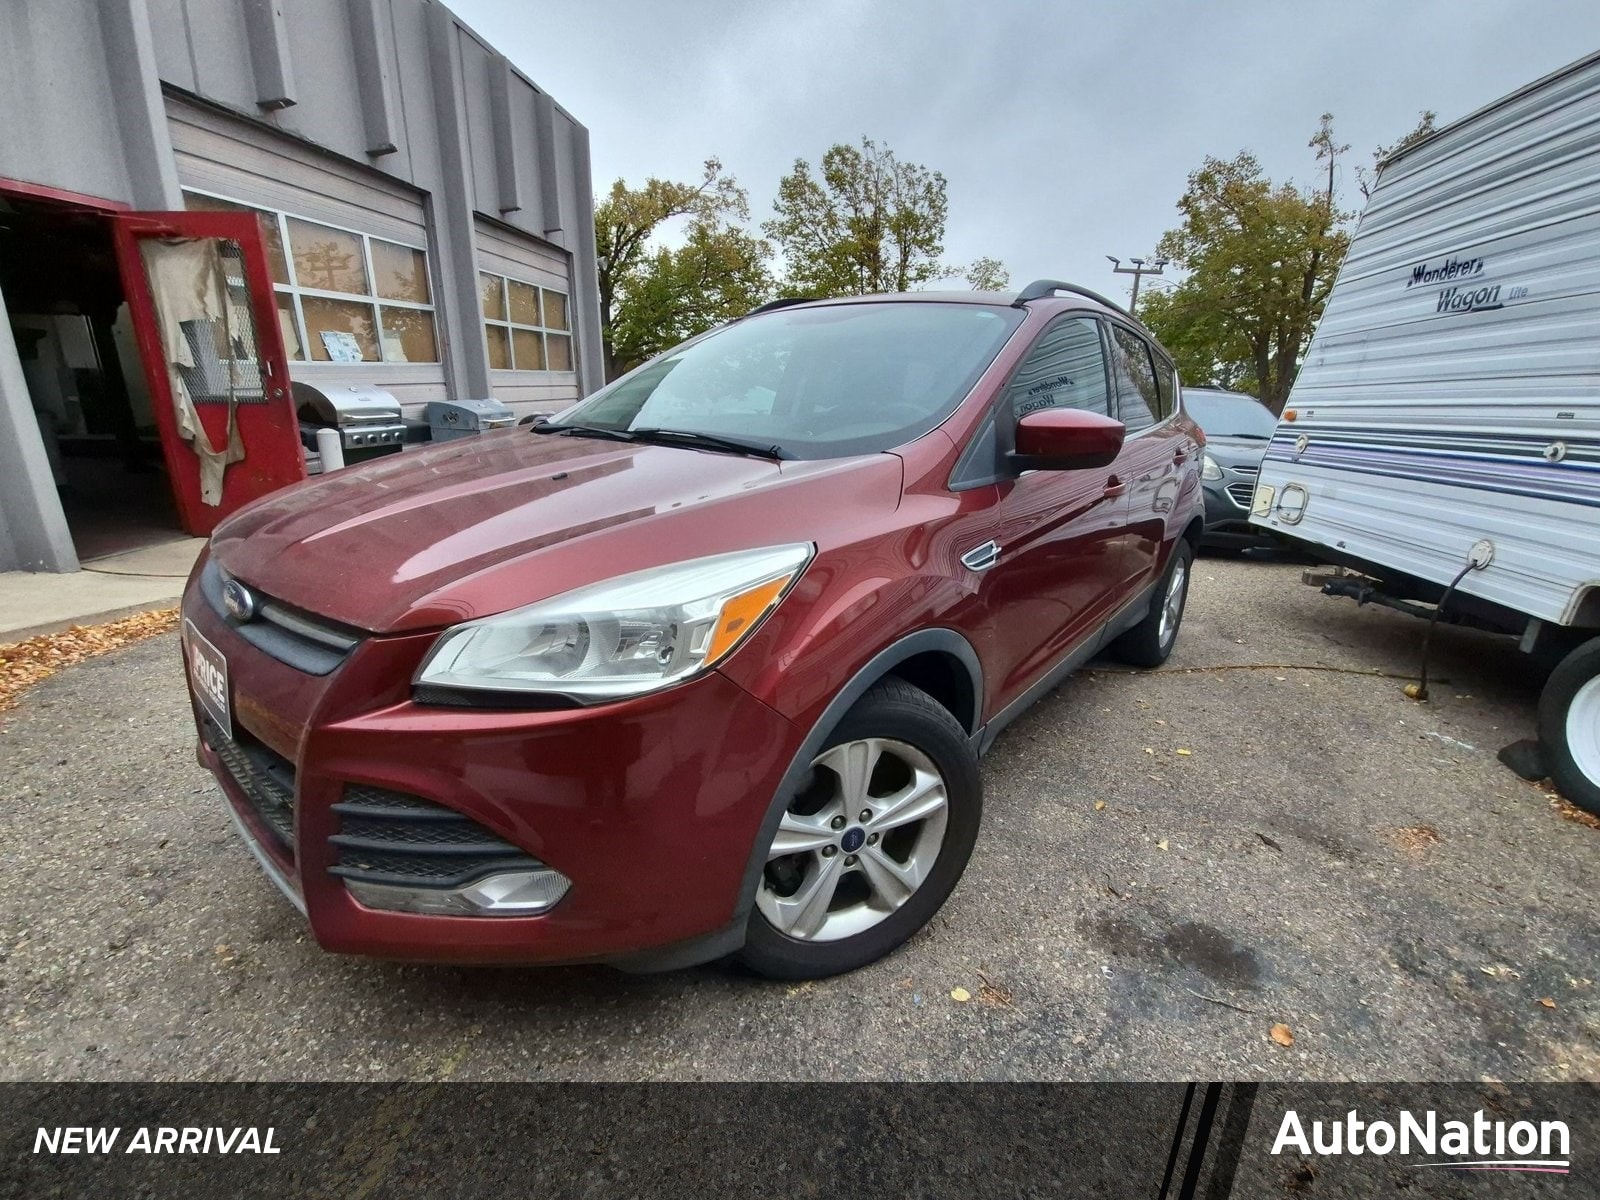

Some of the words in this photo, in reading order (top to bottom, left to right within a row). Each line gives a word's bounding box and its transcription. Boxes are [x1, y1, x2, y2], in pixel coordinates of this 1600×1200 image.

[1412, 257, 1479, 285] Wanderer
[1436, 284, 1502, 312] Wagon
[1508, 286, 1529, 300] Lite
